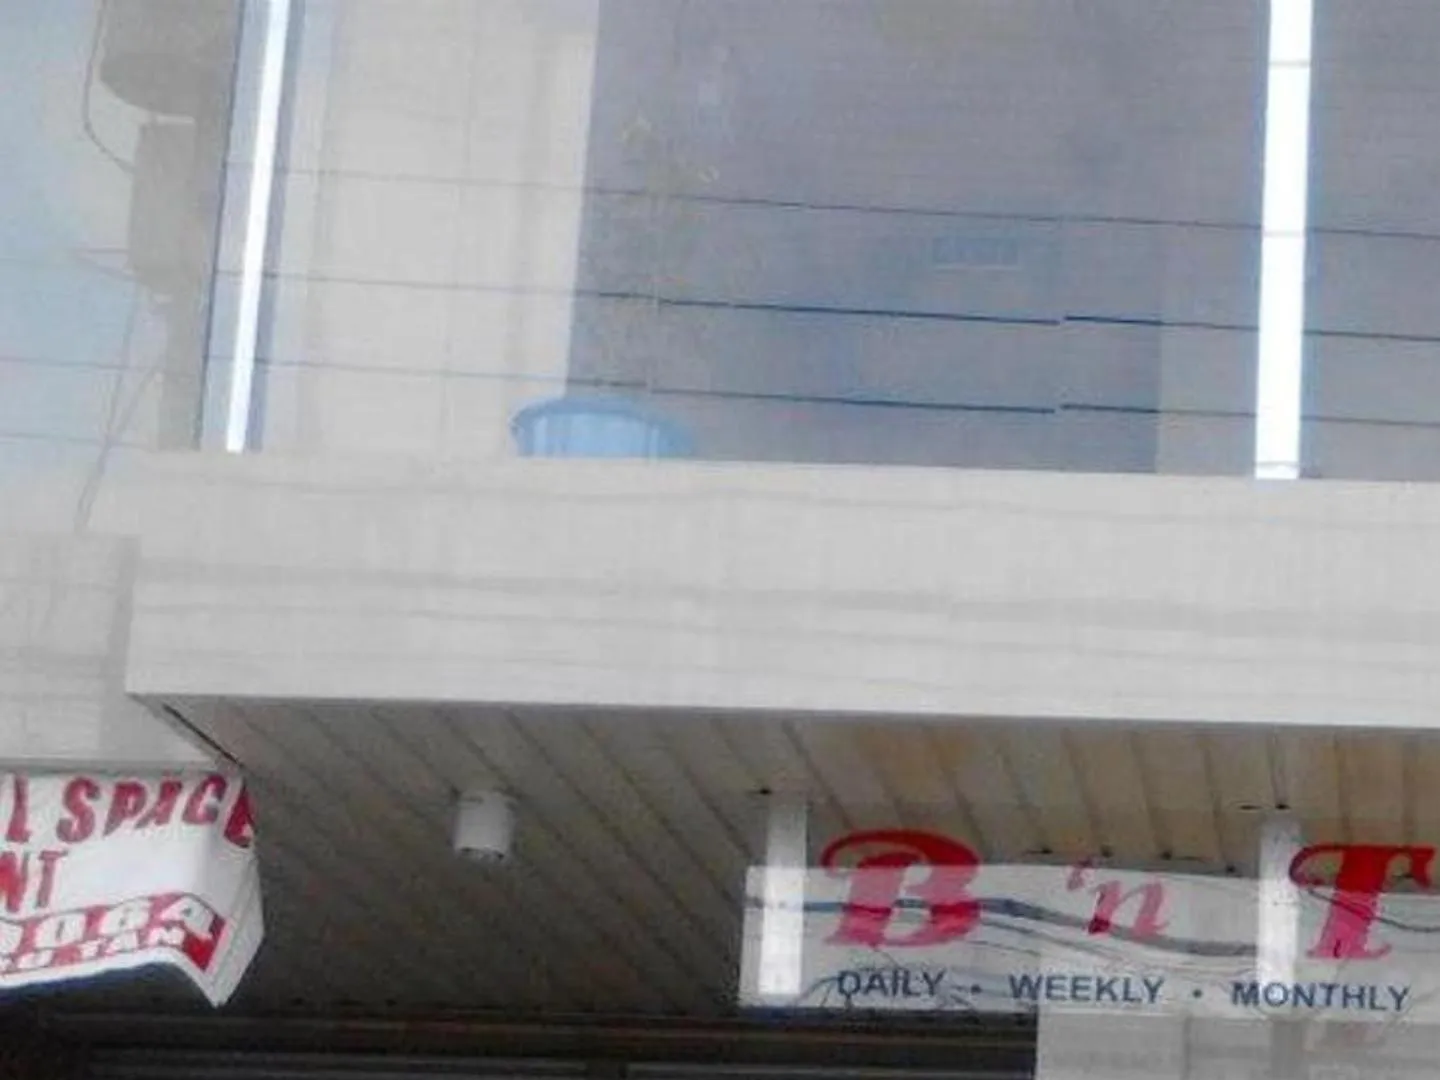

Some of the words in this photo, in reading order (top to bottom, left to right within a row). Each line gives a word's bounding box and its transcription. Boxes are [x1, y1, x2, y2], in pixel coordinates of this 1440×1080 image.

[821, 829, 981, 948] B
[1289, 844, 1437, 959] T
[836, 968, 945, 998] DAILY
[1009, 974, 1165, 1003] WEEKLY
[1230, 981, 1411, 1012] MONTHLY
